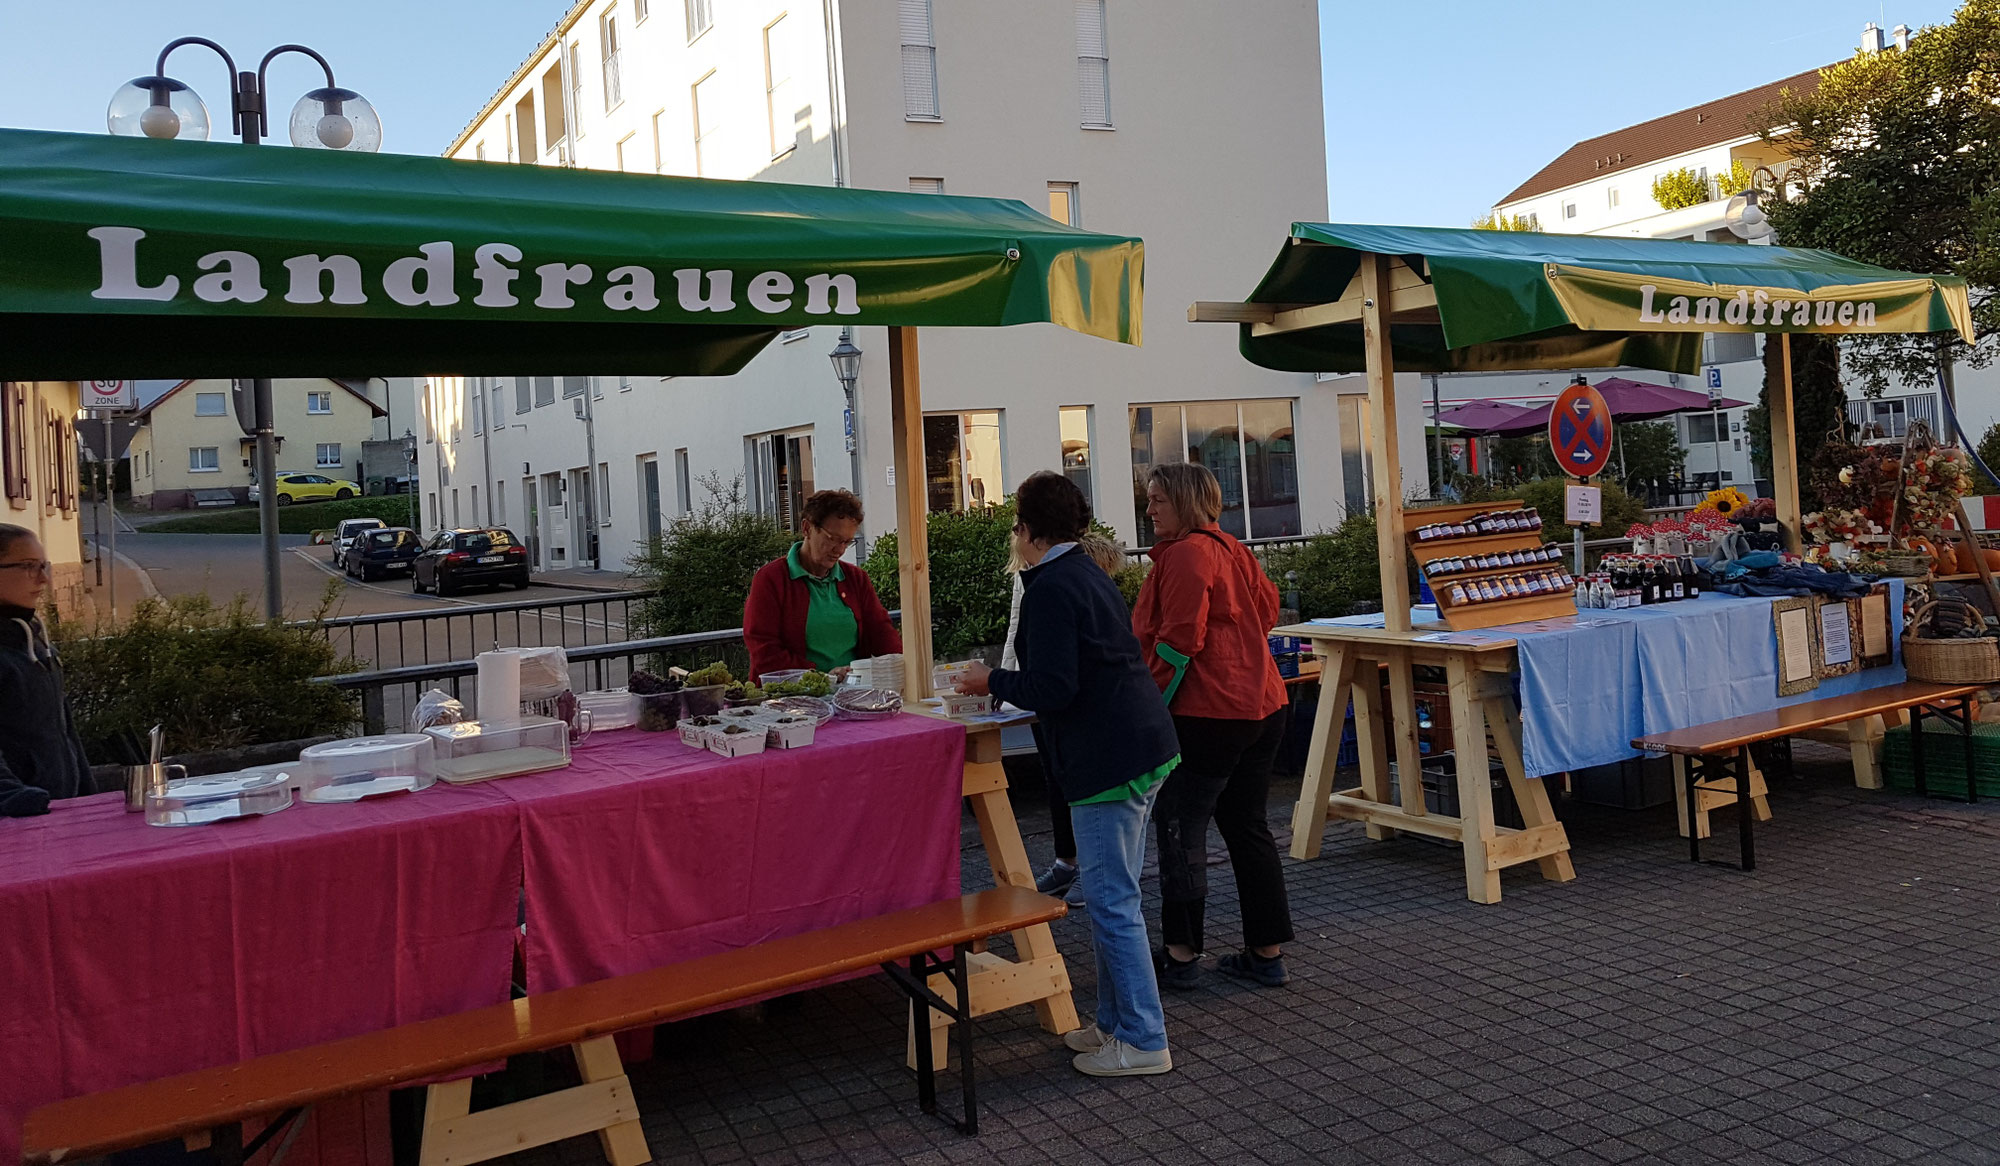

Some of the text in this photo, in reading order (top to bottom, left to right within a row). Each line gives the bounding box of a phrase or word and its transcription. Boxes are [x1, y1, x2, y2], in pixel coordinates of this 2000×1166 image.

[86, 226, 862, 316] Landfrauen
[1638, 285, 1877, 327] Landfrauen
[1710, 370, 1718, 386] P
[95, 396, 120, 405] ZONE
